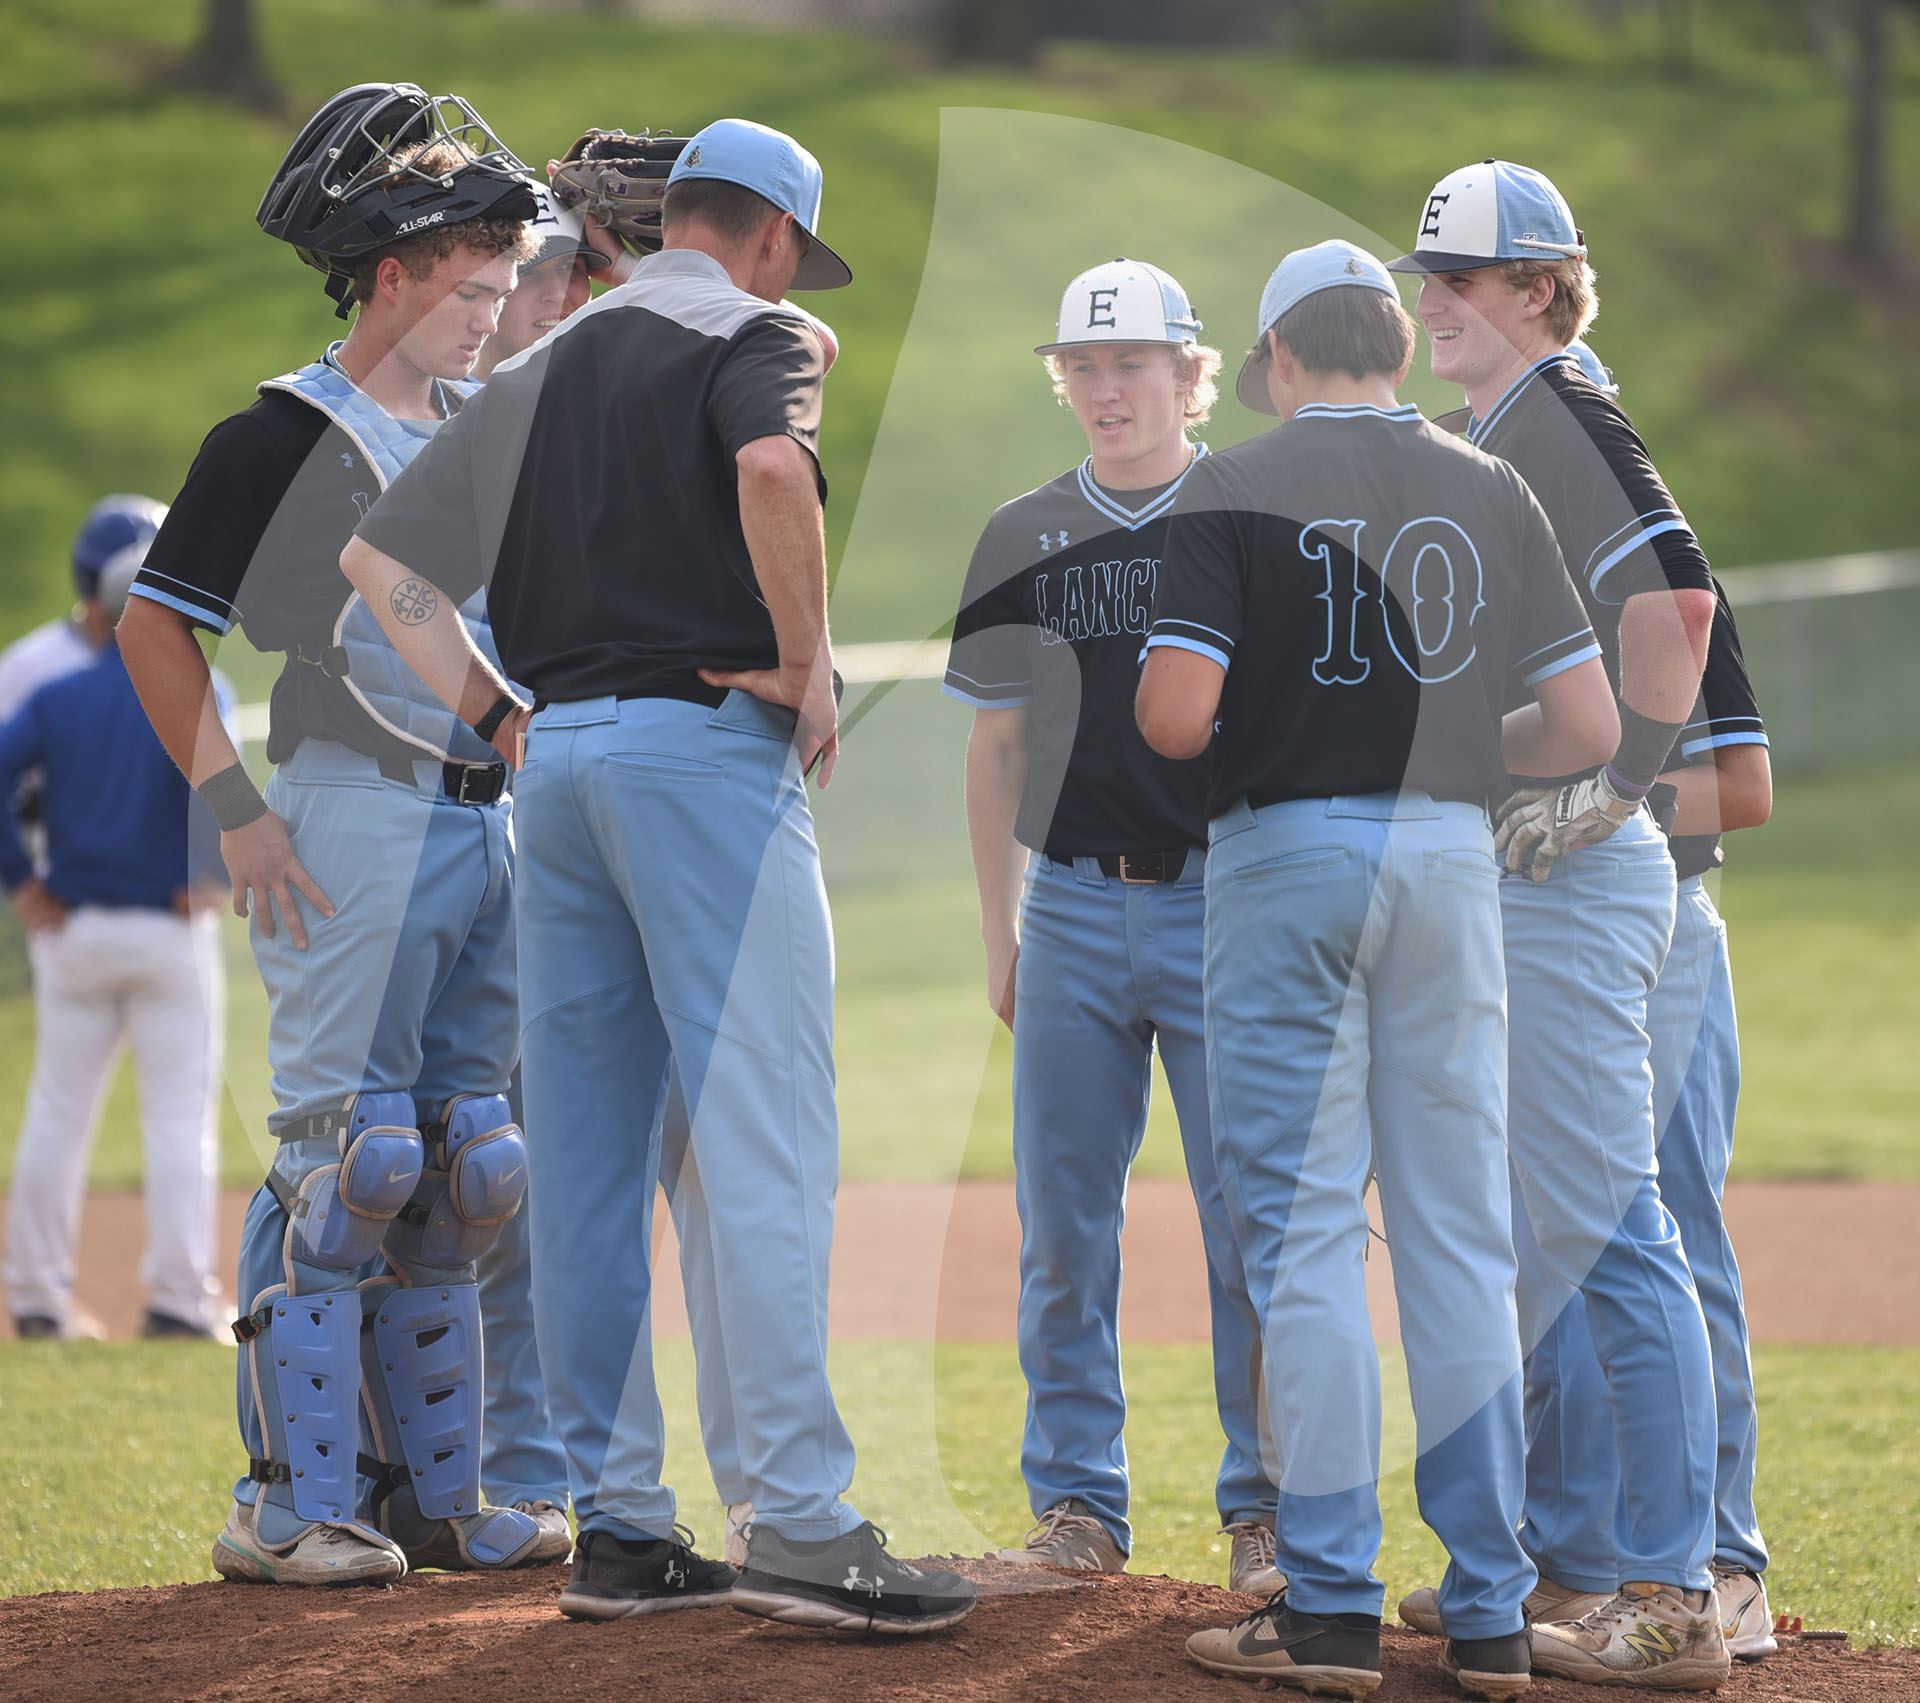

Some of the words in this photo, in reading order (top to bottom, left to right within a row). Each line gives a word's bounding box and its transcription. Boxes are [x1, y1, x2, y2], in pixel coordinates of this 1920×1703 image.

[395, 211, 445, 236] ALL-STAR
[1421, 193, 1451, 239] E
[1087, 286, 1118, 329] E
[1035, 558, 1162, 646] LANC
[1298, 515, 1487, 685] 10
